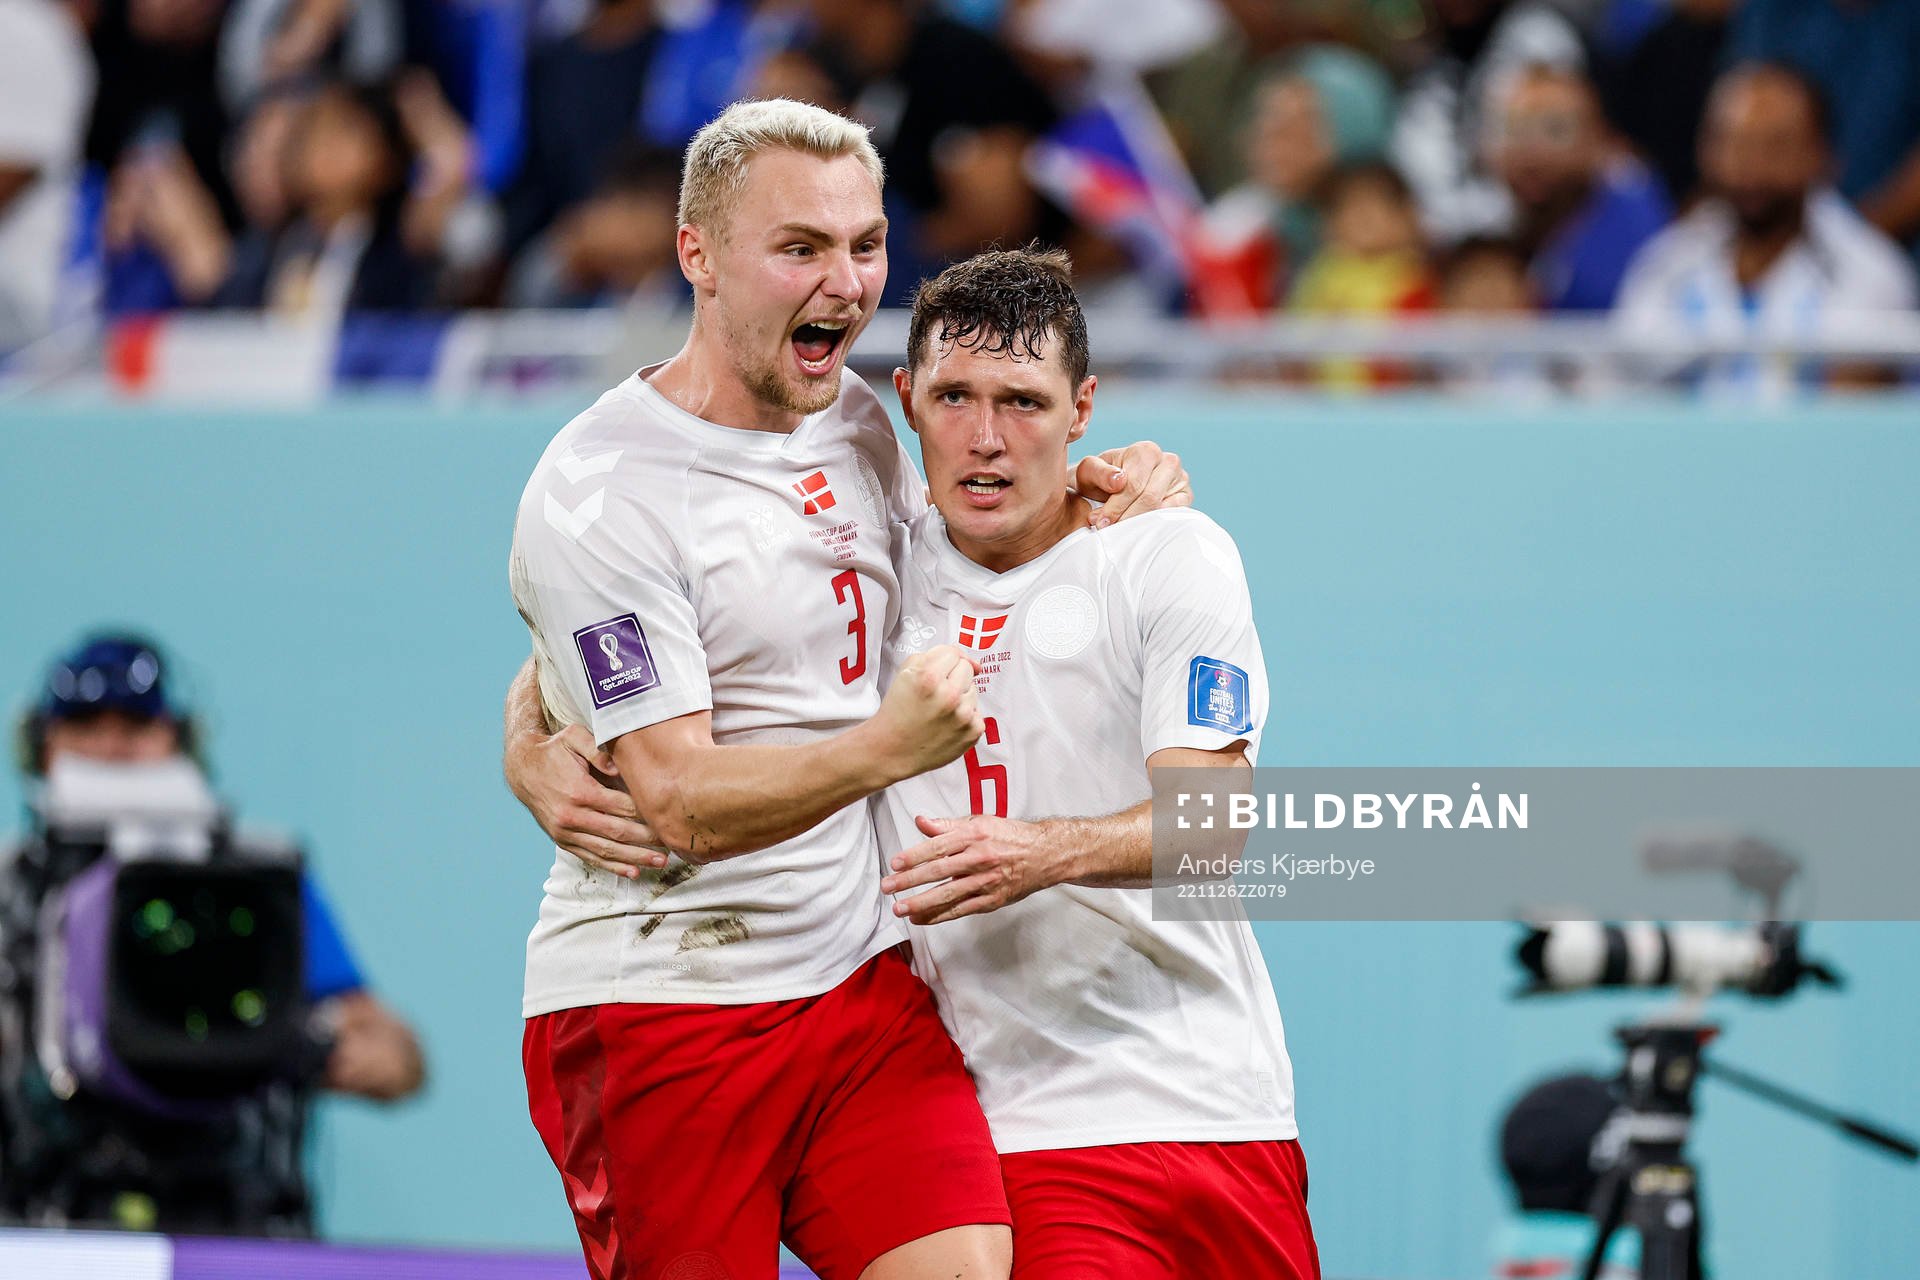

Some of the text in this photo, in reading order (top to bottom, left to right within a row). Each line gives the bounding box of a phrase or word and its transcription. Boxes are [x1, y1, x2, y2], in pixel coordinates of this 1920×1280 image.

[831, 568, 866, 685] 3
[998, 652, 1011, 661] 2022
[599, 666, 642, 687] FIFA WORLD CUP
[974, 677, 990, 685] EMBER
[1210, 694, 1235, 709] UNITES
[964, 717, 1007, 817] 6
